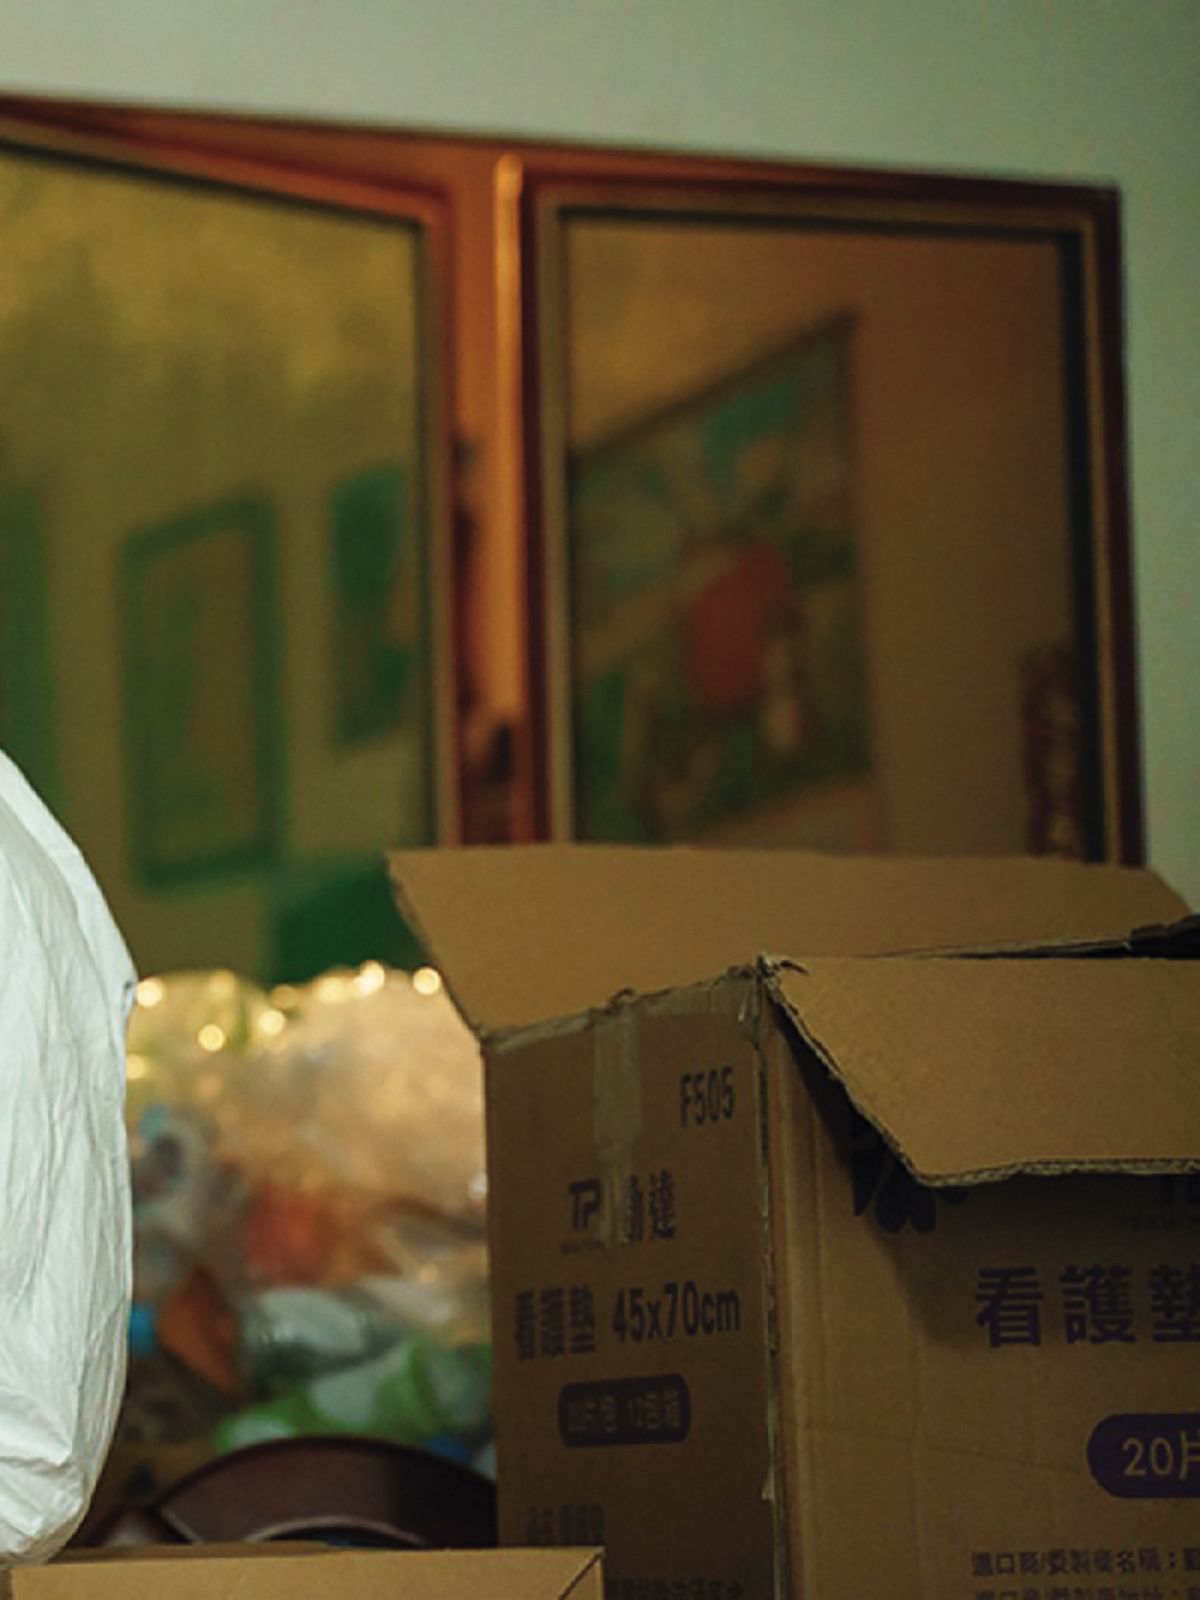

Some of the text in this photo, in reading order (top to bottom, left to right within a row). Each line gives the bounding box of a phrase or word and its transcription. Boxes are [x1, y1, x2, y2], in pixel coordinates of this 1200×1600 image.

[680, 1066, 735, 1128] F505
[612, 1281, 740, 1342] 45x70cm
[975, 1264, 1200, 1347] 看護墊
